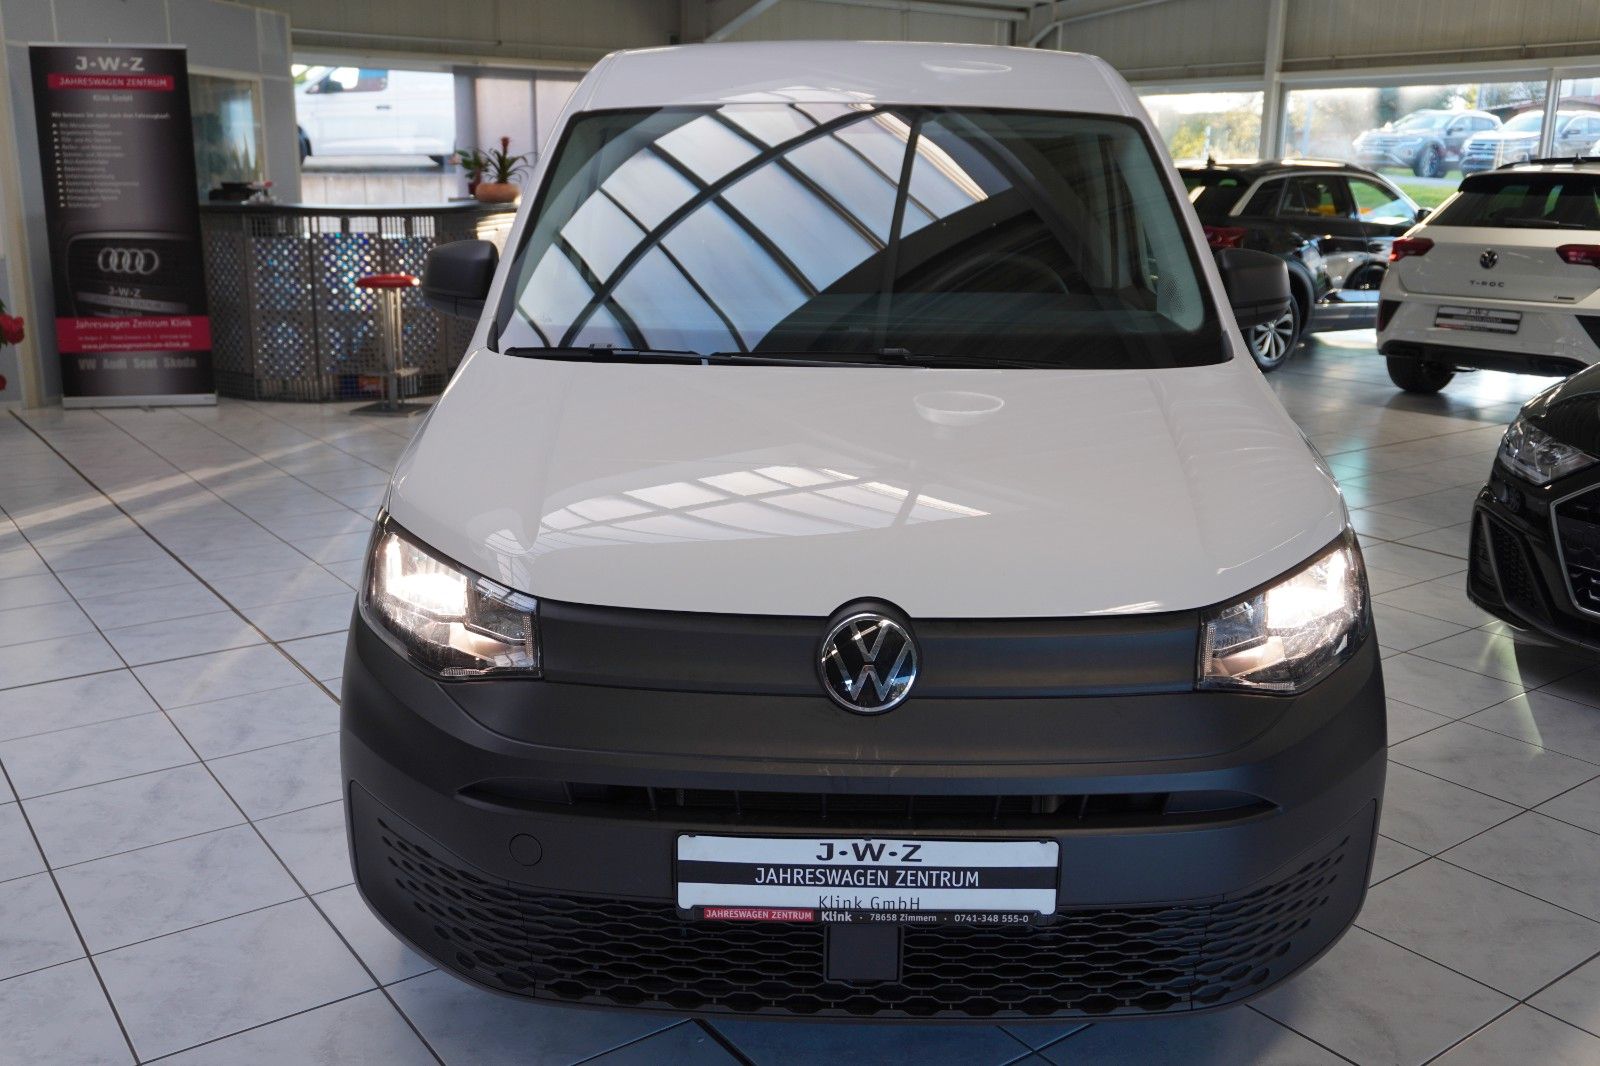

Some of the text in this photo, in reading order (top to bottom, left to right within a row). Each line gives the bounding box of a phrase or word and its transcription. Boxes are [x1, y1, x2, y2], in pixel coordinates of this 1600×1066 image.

[59, 76, 167, 88] JAHRESWAGEN ZENTRUM
[76, 319, 192, 331] Jahreswagen Zentrum Klink
[754, 867, 979, 887] JAHRESWAGEN ZENTRUM
[818, 895, 920, 911] Klink GmbH
[705, 909, 1029, 923] JAHRESWAGEN ZENTRUM Klink 78658 Zimmern 0741-348 555-0
